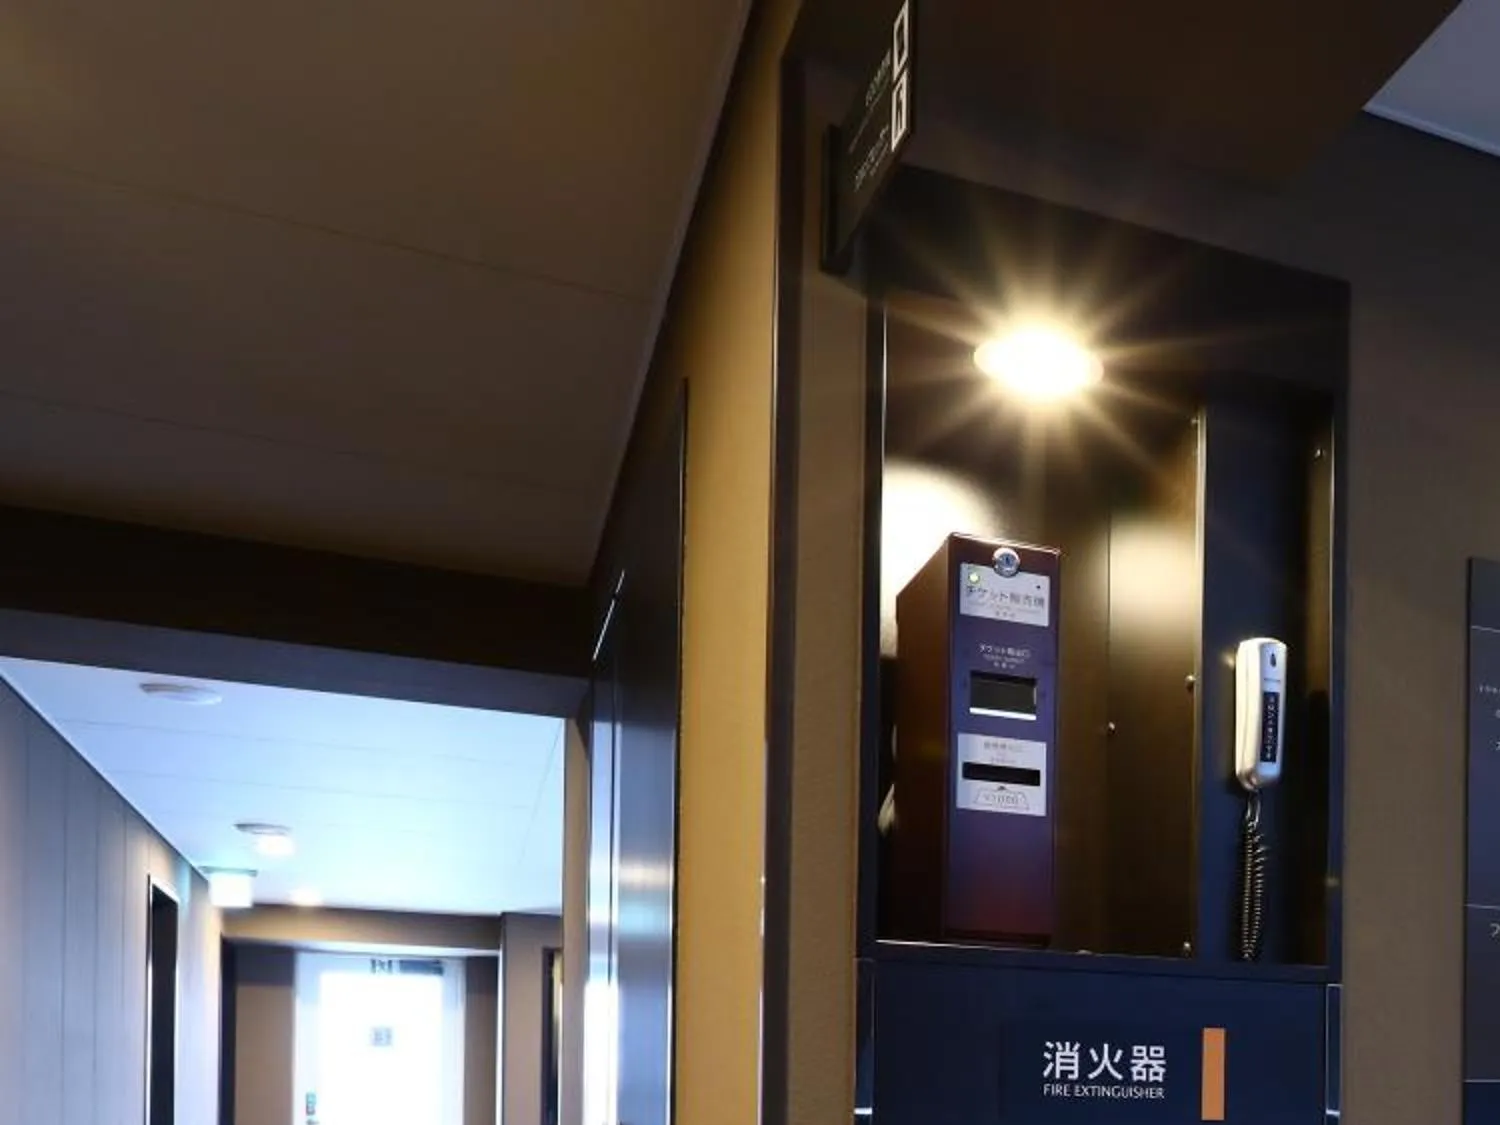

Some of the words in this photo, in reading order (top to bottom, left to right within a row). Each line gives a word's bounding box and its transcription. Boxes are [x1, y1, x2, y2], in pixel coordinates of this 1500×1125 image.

[1042, 1040, 1167, 1082] 消火器
[1043, 1083, 1071, 1097] FIRE
[1074, 1084, 1166, 1100] EXTINGUISHER
